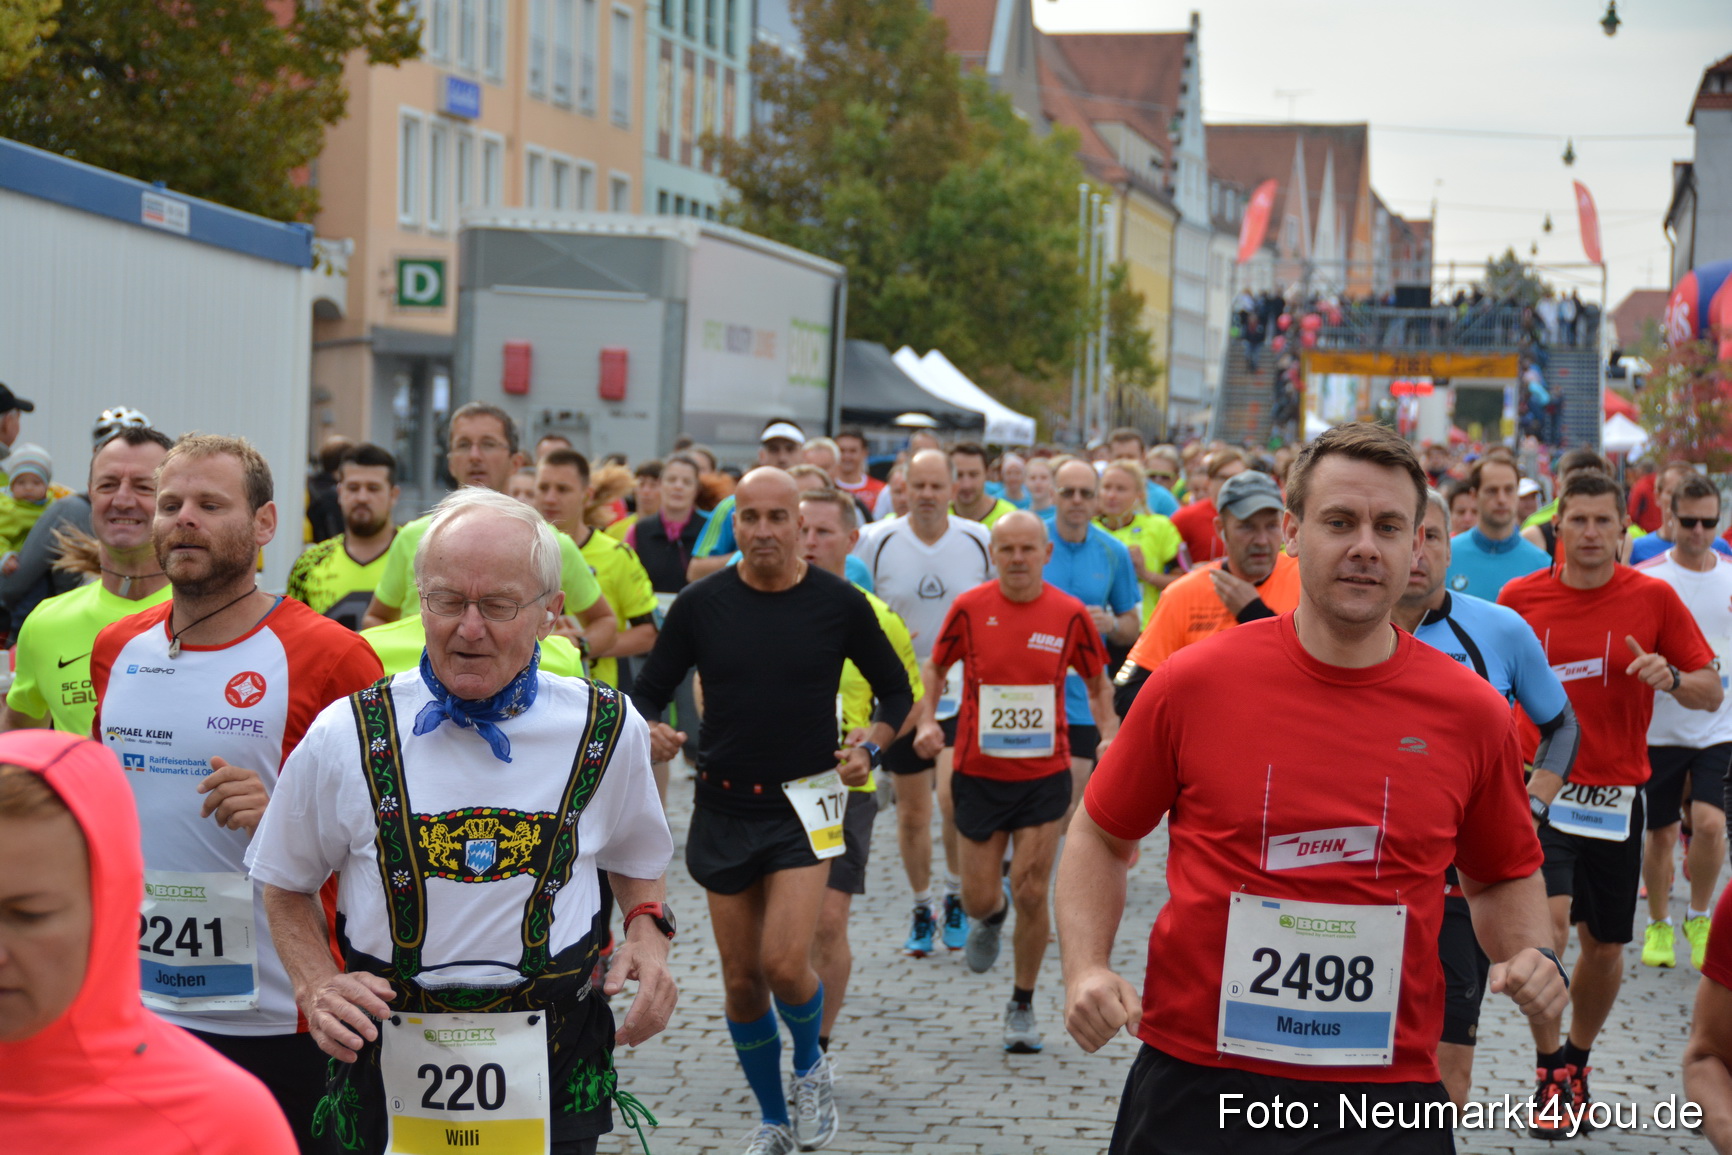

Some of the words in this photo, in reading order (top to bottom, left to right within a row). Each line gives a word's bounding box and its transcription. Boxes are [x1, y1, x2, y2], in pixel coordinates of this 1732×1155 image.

[1028, 632, 1065, 649] JURA
[1565, 666, 1589, 676] DEHN
[61, 681, 78, 692] SC
[206, 716, 265, 734] KOPPE
[990, 708, 1044, 729] 2332
[106, 726, 143, 738] MICHAEL
[146, 729, 174, 740] KLEIN
[149, 755, 207, 767] Raiffeisenbank
[149, 765, 189, 776] Neumarkt
[1560, 783, 1623, 808] 2062
[1571, 810, 1604, 825] Thomas
[1297, 838, 1347, 857] DEHN
[155, 884, 208, 899] BOCK
[1296, 916, 1357, 934] BOCK
[154, 969, 207, 988] Jochen
[1249, 947, 1375, 1003] 2498
[438, 1027, 497, 1042] BOCK
[1276, 1015, 1342, 1037] Markus
[417, 1062, 507, 1111] 220
[445, 1129, 480, 1147] Willi
